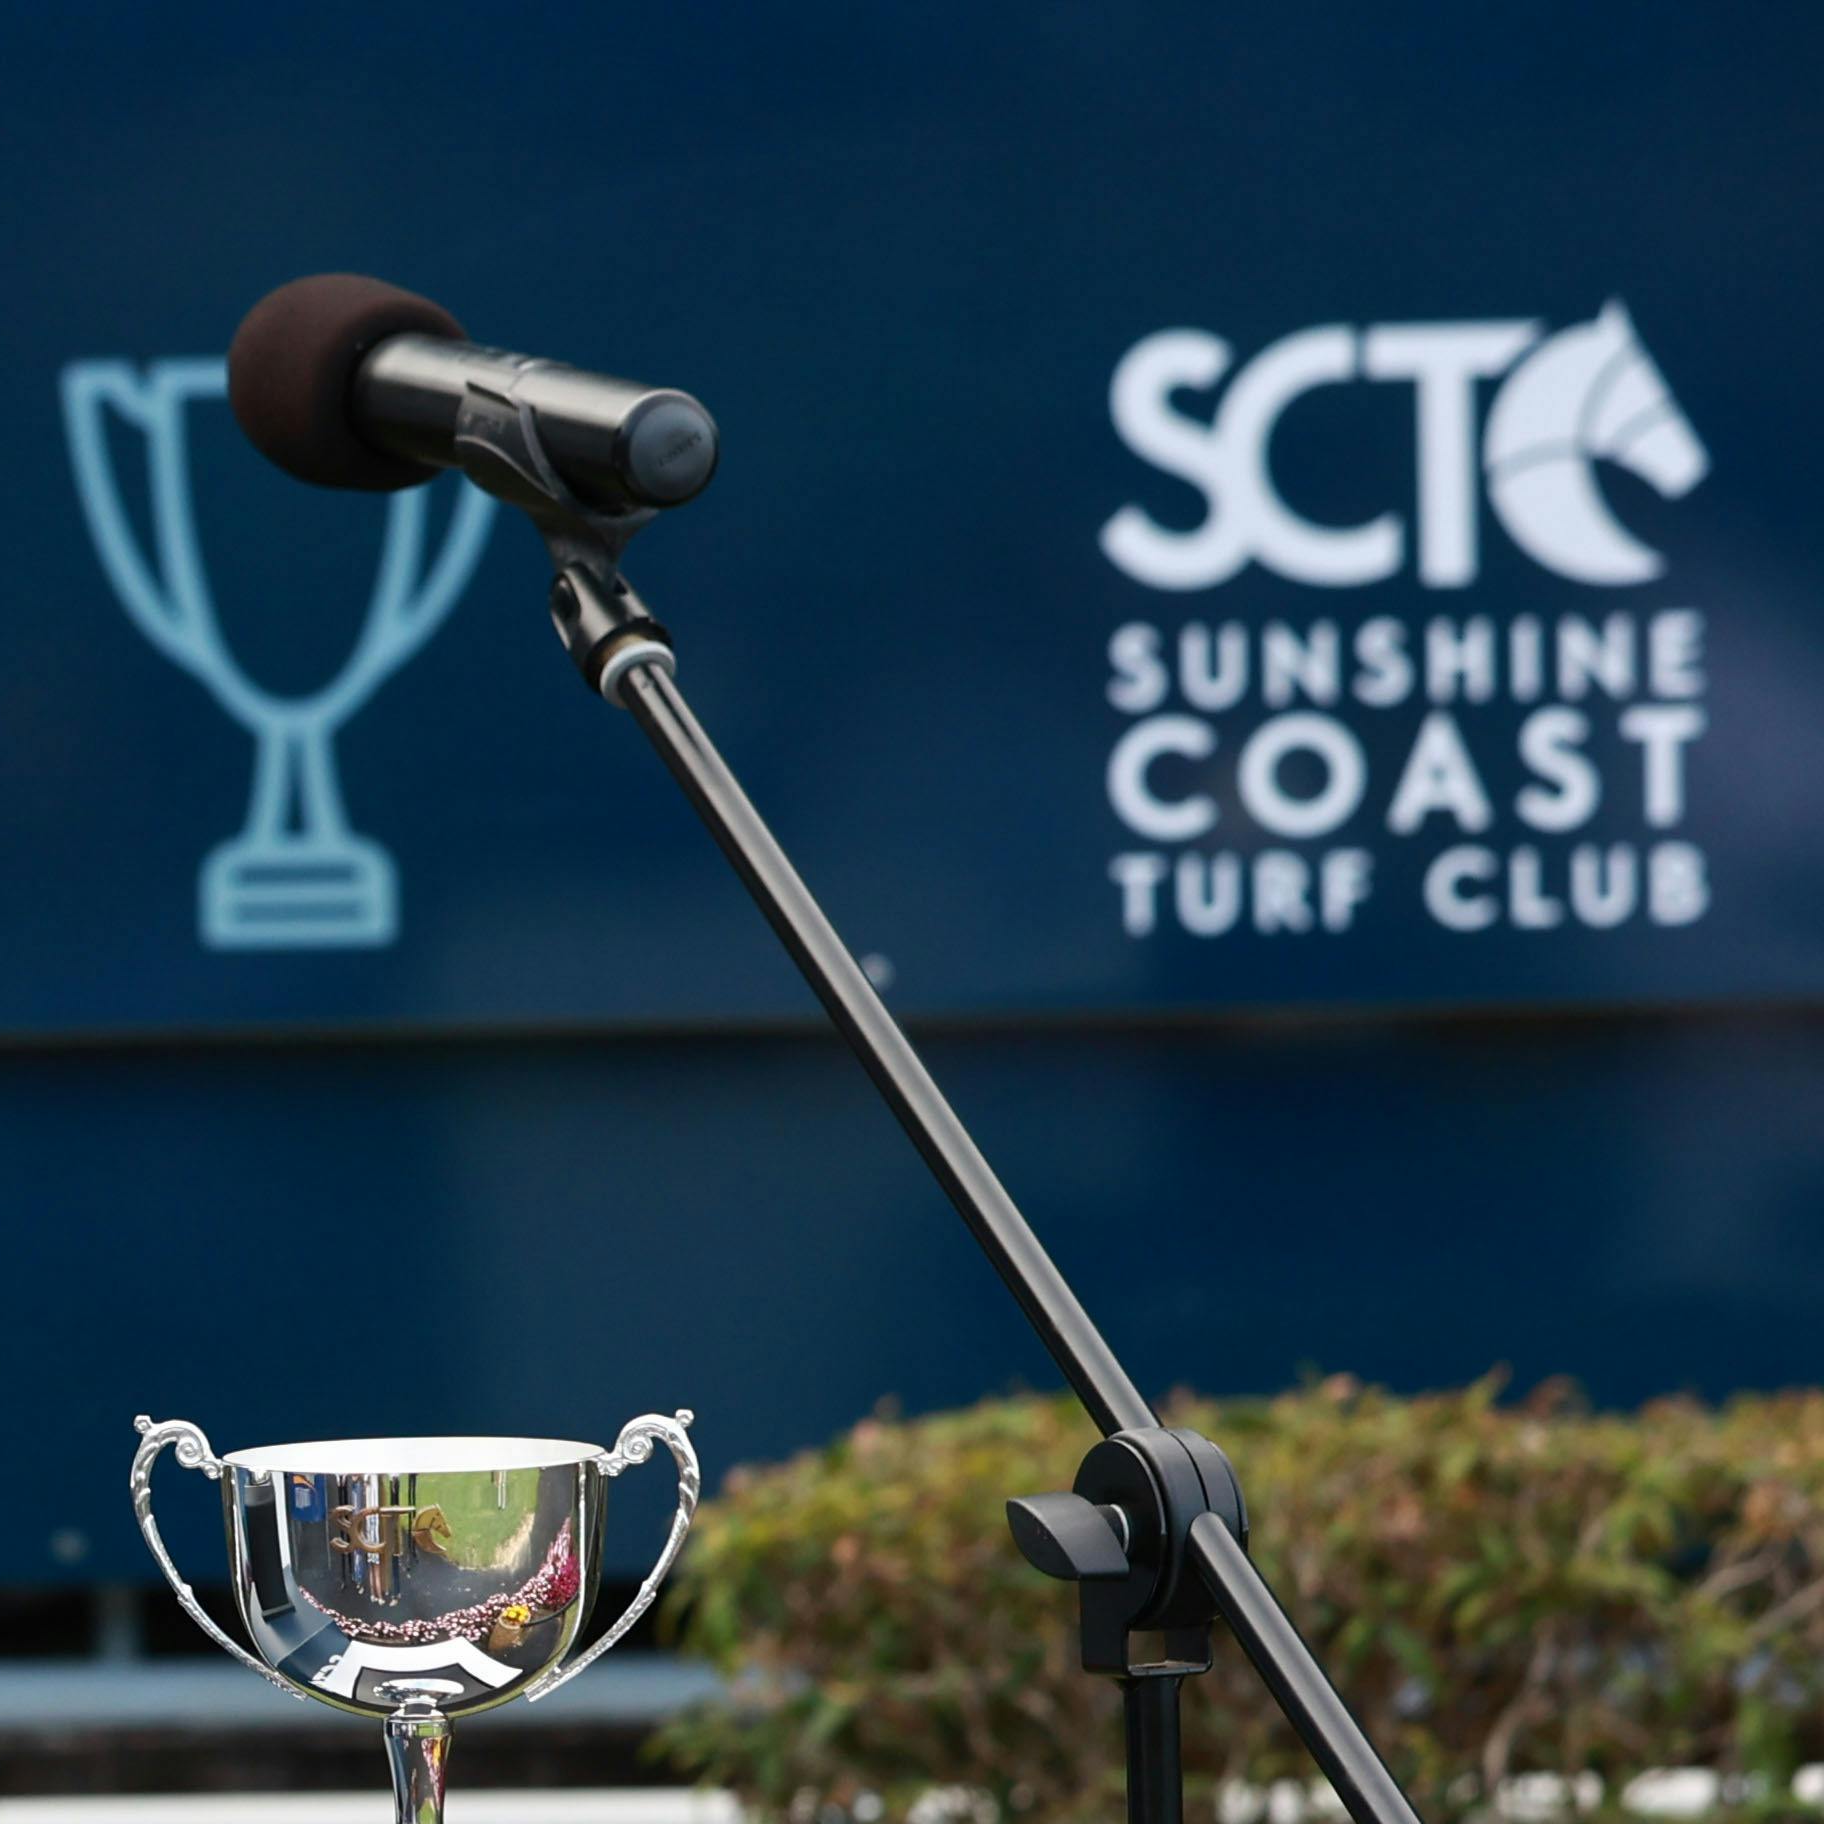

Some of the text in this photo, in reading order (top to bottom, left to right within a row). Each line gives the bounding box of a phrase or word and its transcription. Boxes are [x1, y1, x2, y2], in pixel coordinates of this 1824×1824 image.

[1107, 610, 1706, 709] SUNSHINE
[1107, 702, 1706, 840] COAST
[1110, 843, 1709, 936] TURF CLUB
